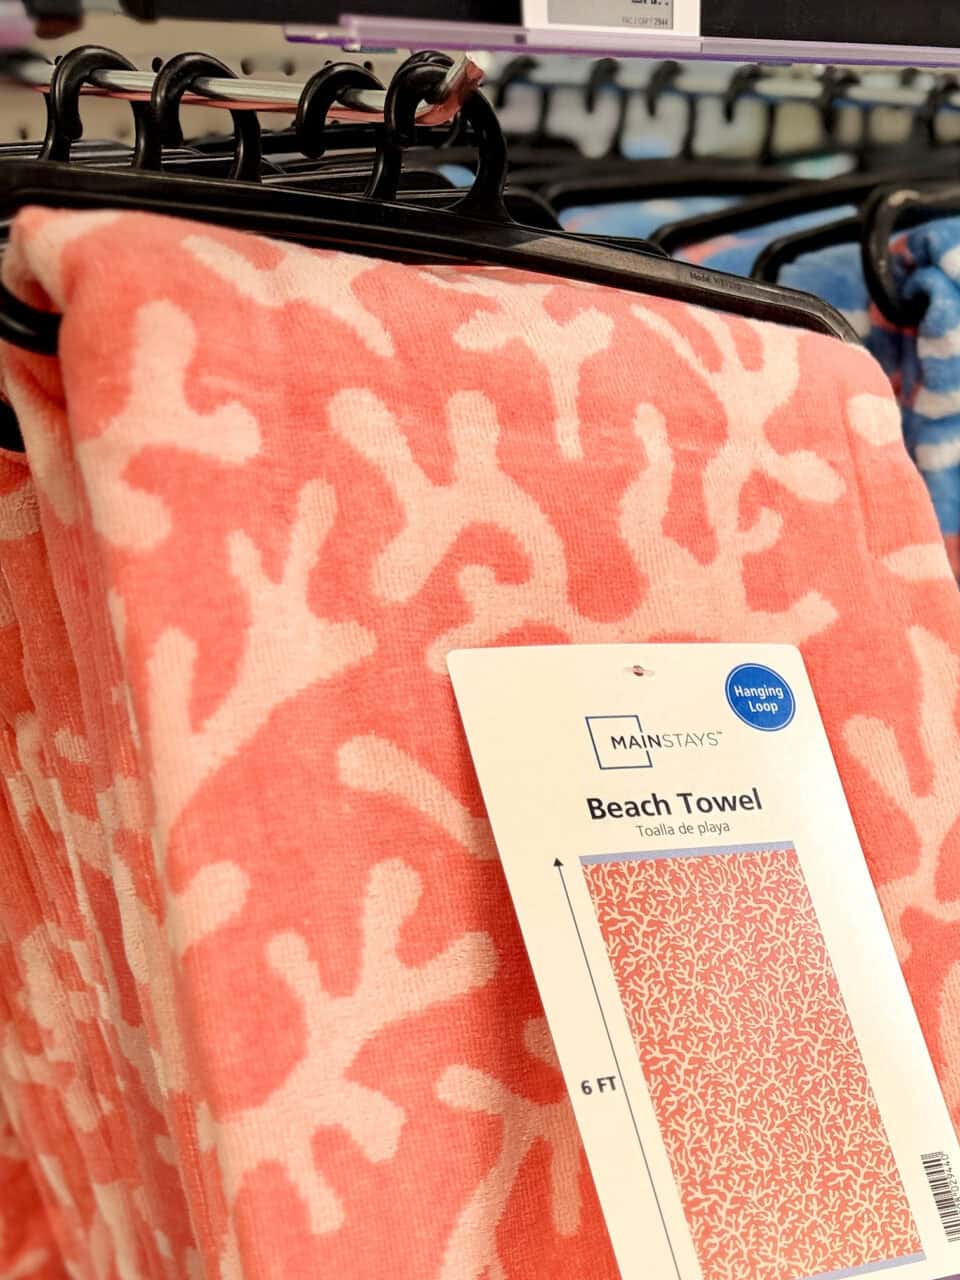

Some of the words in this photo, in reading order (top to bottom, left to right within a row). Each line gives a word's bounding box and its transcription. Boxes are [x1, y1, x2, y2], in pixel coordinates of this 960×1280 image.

[733, 684, 784, 700] Hanging
[748, 701, 778, 714] Loop
[586, 793, 672, 820] Beach
[676, 787, 762, 815] Towel
[636, 823, 676, 838] Toalla
[678, 821, 694, 834] de
[697, 820, 731, 835] playa
[581, 1080, 592, 1095] 6
[597, 1076, 616, 1092] FT
